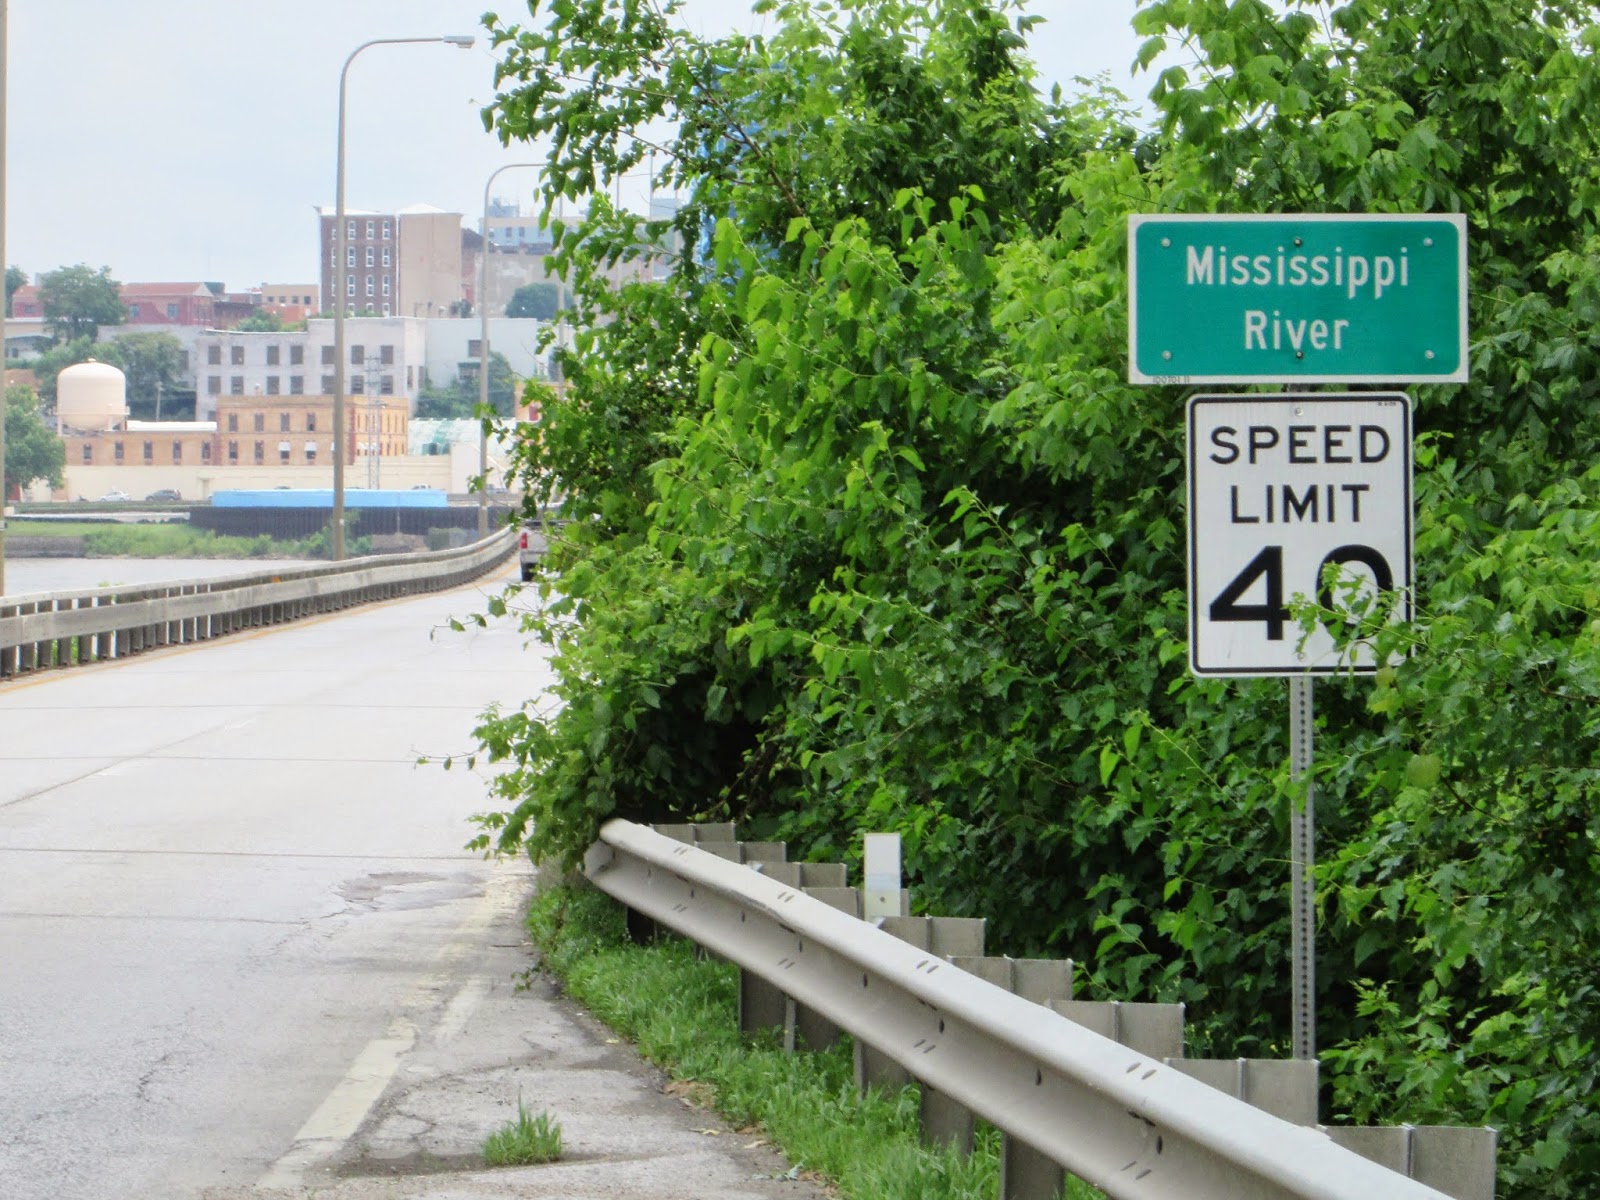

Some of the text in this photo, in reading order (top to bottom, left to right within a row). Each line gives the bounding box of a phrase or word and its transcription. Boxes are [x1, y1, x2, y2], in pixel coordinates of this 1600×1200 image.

[1186, 245, 1409, 299] Mississippi
[1244, 310, 1349, 350] River
[1209, 424, 1391, 465] SPEED
[1230, 484, 1370, 523] LIMIT
[1209, 544, 1394, 641] 40
